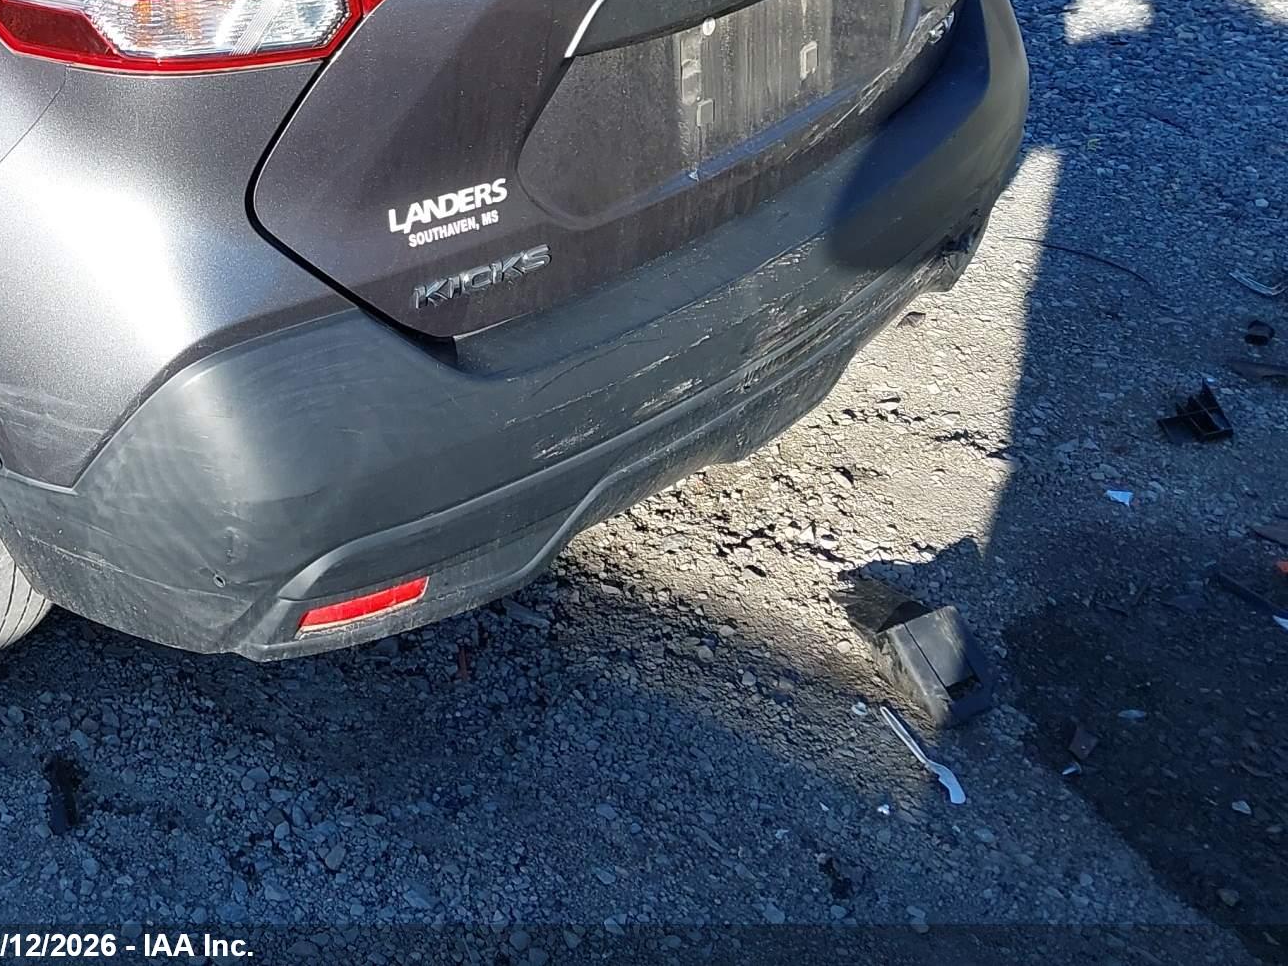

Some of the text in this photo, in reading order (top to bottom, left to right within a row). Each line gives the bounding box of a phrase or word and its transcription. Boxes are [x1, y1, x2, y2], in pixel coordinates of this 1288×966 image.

[388, 177, 508, 234] LANDERS
[408, 209, 499, 248] SOUTHAVEN, MS
[414, 243, 552, 309] KICKS
